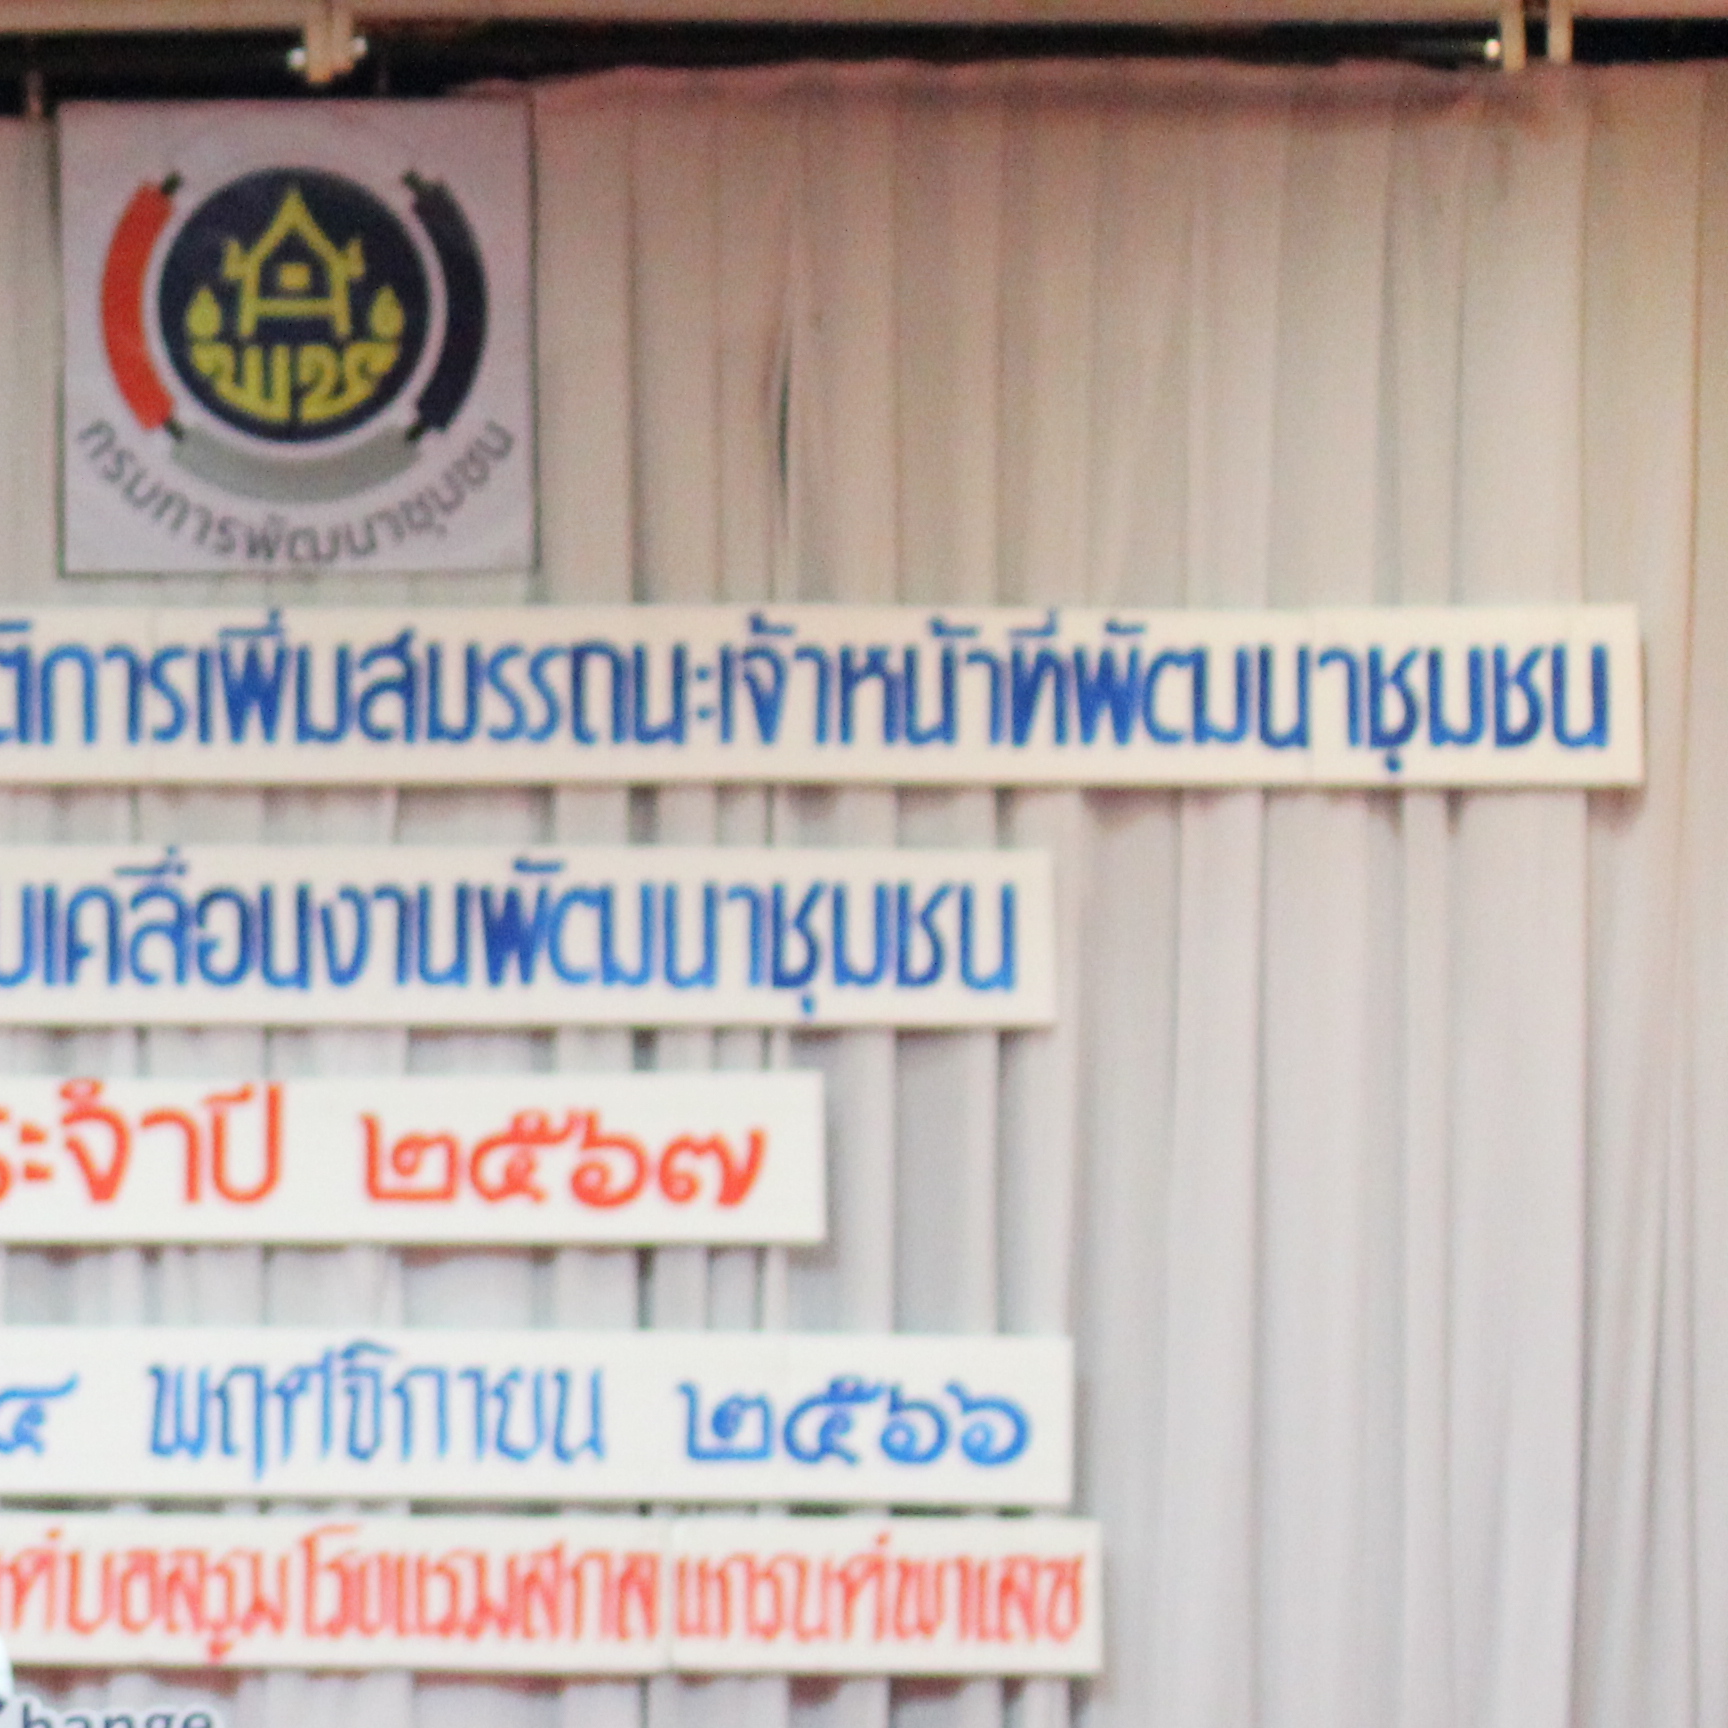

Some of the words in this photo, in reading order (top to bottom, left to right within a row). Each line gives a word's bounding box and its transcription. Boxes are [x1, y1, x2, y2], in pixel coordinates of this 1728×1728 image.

[79, 418, 517, 565] กรมการพัฒนาชุมชน
[362, 1110, 766, 1209] ๒๕๖๗
[147, 1341, 606, 1480] พฤศจิกายน
[678, 1377, 1032, 1468] ๒๕๖๖
